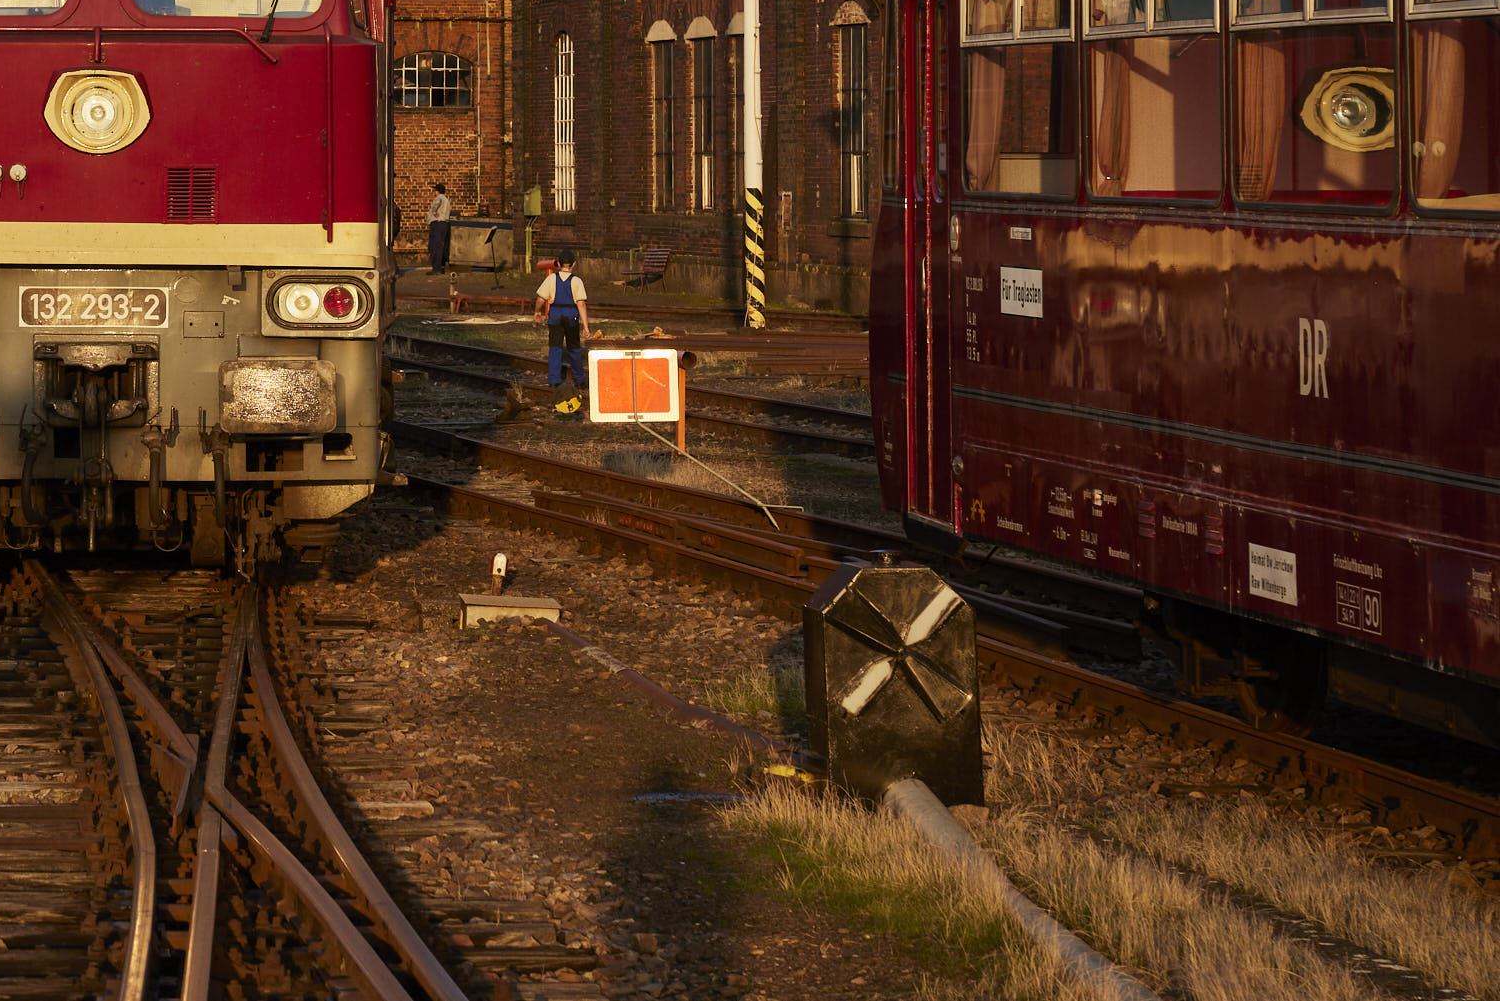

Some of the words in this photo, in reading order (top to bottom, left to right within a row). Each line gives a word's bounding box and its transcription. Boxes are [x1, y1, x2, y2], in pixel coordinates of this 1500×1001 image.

[30, 293, 72, 320] 132
[80, 293, 160, 320] 293-2
[1002, 278, 1011, 300] Für
[1012, 280, 1042, 308] Traglasten
[1299, 317, 1329, 399] DR
[1251, 551, 1265, 567] Heimat
[1273, 556, 1293, 574] Jerichow
[1333, 552, 1373, 580] Frischluftheizung
[1251, 574, 1260, 588] Raw
[1261, 577, 1287, 600] Wittenberge
[1364, 594, 1380, 628] 90
